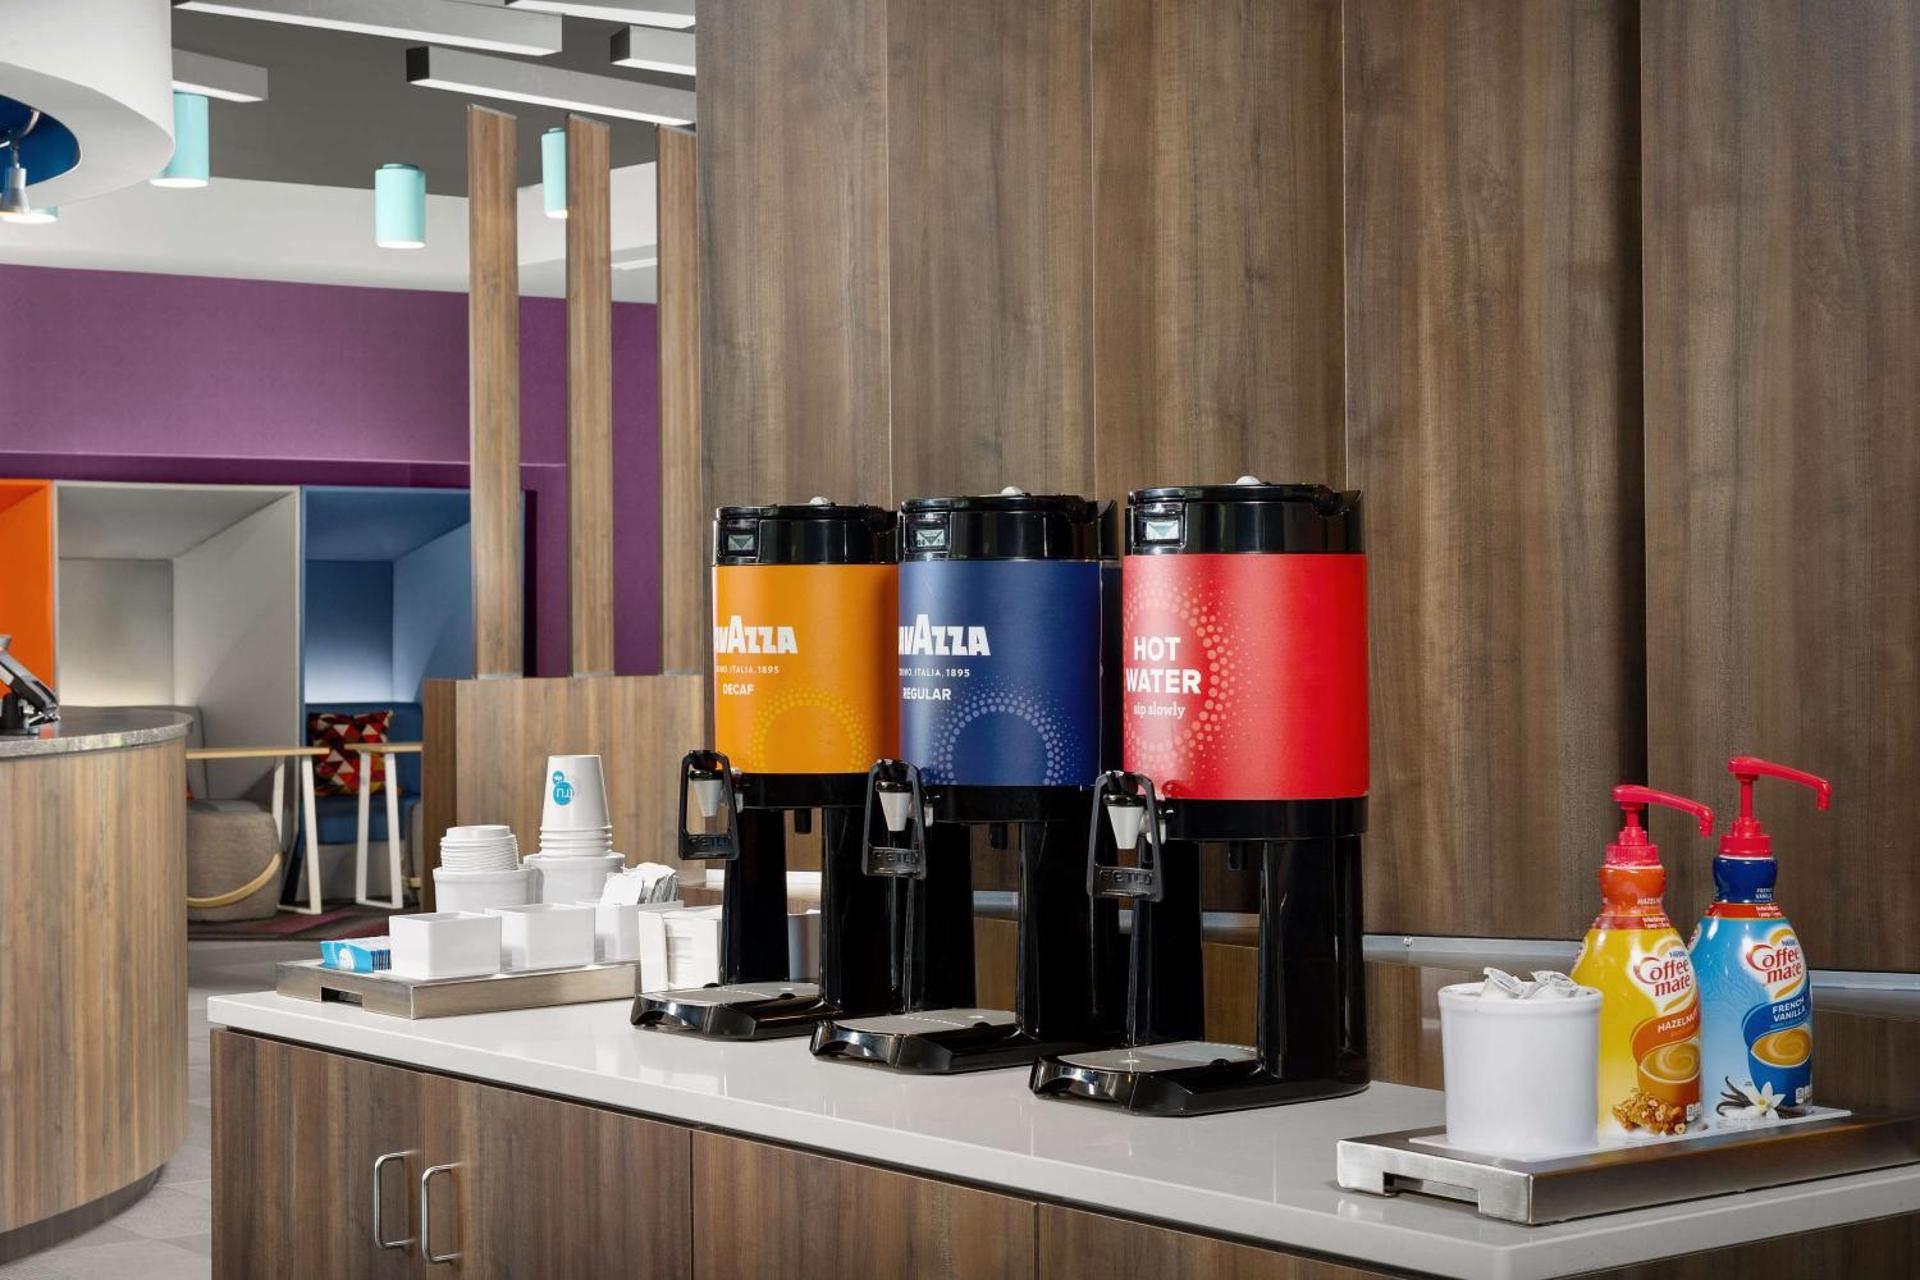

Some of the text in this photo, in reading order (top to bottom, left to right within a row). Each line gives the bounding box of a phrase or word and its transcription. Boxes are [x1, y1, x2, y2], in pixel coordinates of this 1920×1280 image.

[1133, 636, 1181, 661] HOT
[757, 665, 779, 674] 1895
[946, 668, 970, 678] 1895
[722, 683, 754, 696] DECAF
[1125, 668, 1202, 694] WATER
[903, 687, 952, 700] REGULAR
[1133, 701, 1186, 719] sip slowly
[1746, 943, 1800, 971] Coffee
[1633, 956, 1689, 984] Coffee
[1767, 961, 1802, 984] mate
[1655, 973, 1691, 997] mate
[1772, 995, 1805, 1014] FRENCH
